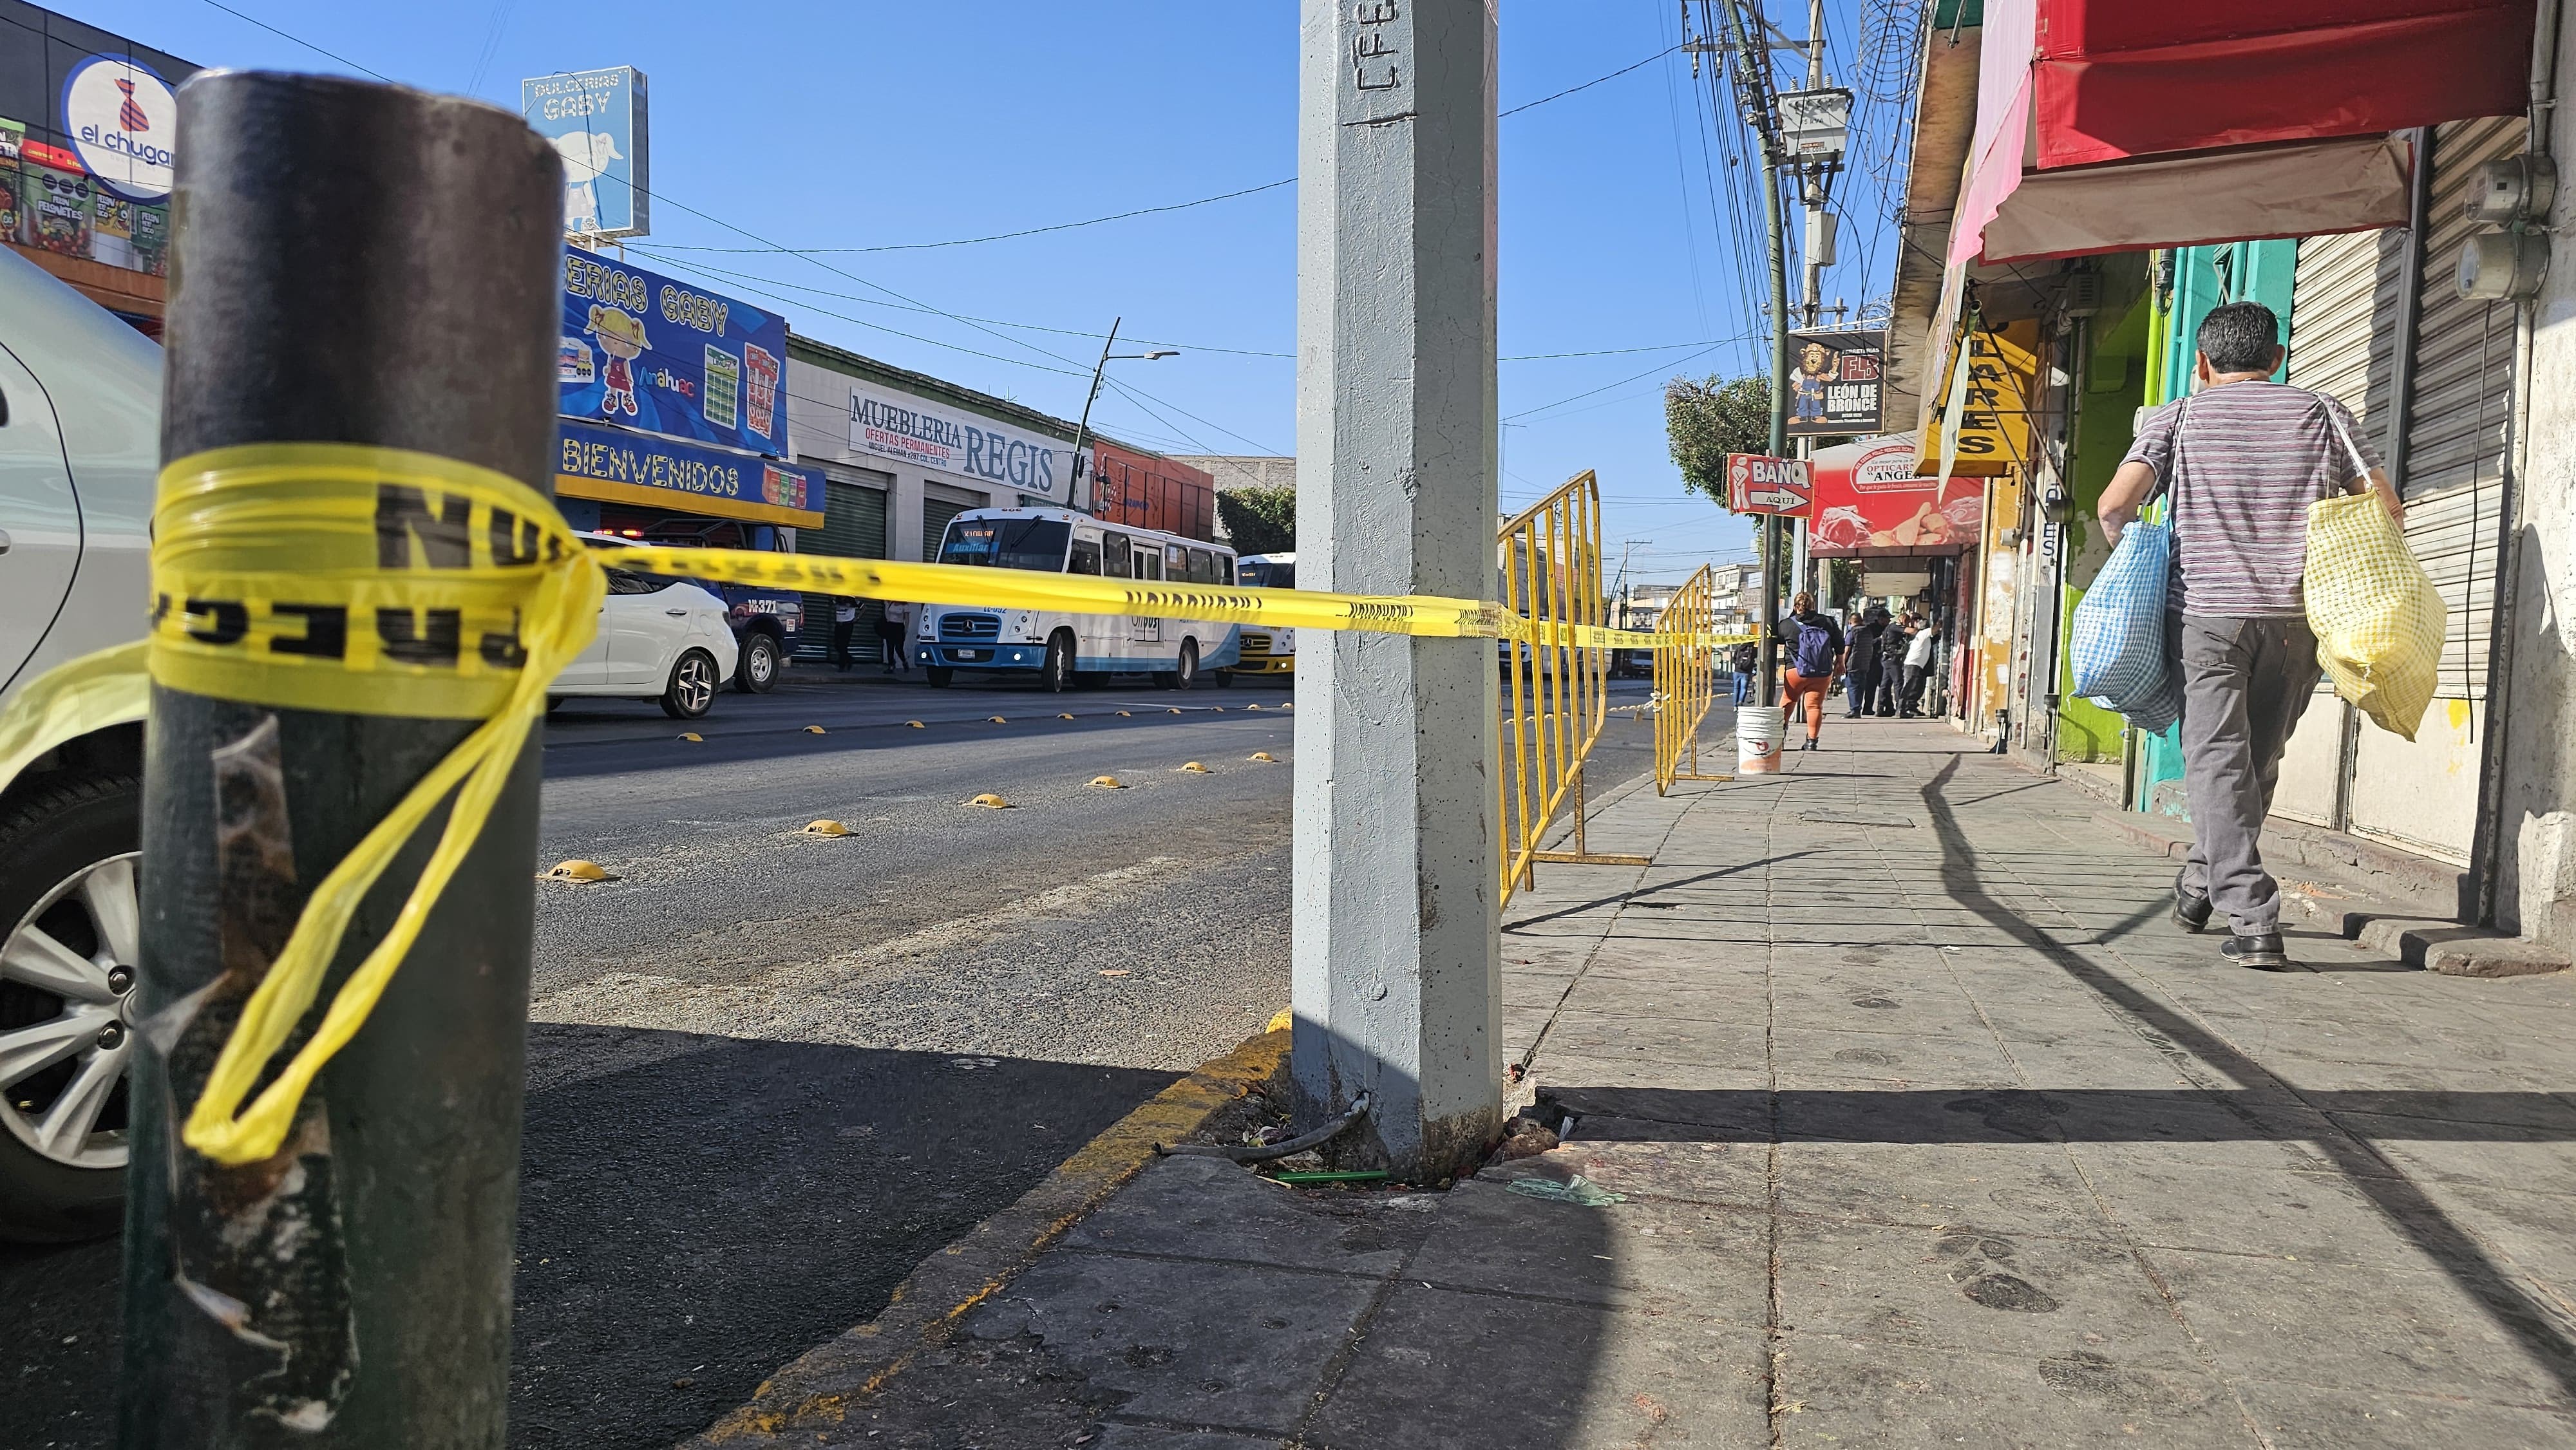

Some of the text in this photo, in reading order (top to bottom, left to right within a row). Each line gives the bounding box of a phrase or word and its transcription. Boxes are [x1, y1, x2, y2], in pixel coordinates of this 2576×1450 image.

[544, 91, 611, 121] GABY
[81, 124, 99, 144] el
[565, 255, 728, 337] ERIAS GABY
[1827, 398, 1877, 413] BRONCE
[1828, 383, 1877, 399] LEÓN DE
[851, 395, 962, 449] MUEBLERIA
[866, 428, 950, 460] OFERTAS PERMANENTES
[869, 441, 886, 453] MIGUEL
[887, 446, 907, 458] ALEMAN
[931, 458, 947, 467] CENTRO
[963, 425, 1052, 493] REGIS
[562, 438, 739, 496] BIENVENIDOS
[1766, 496, 1795, 505] AQUÍ
